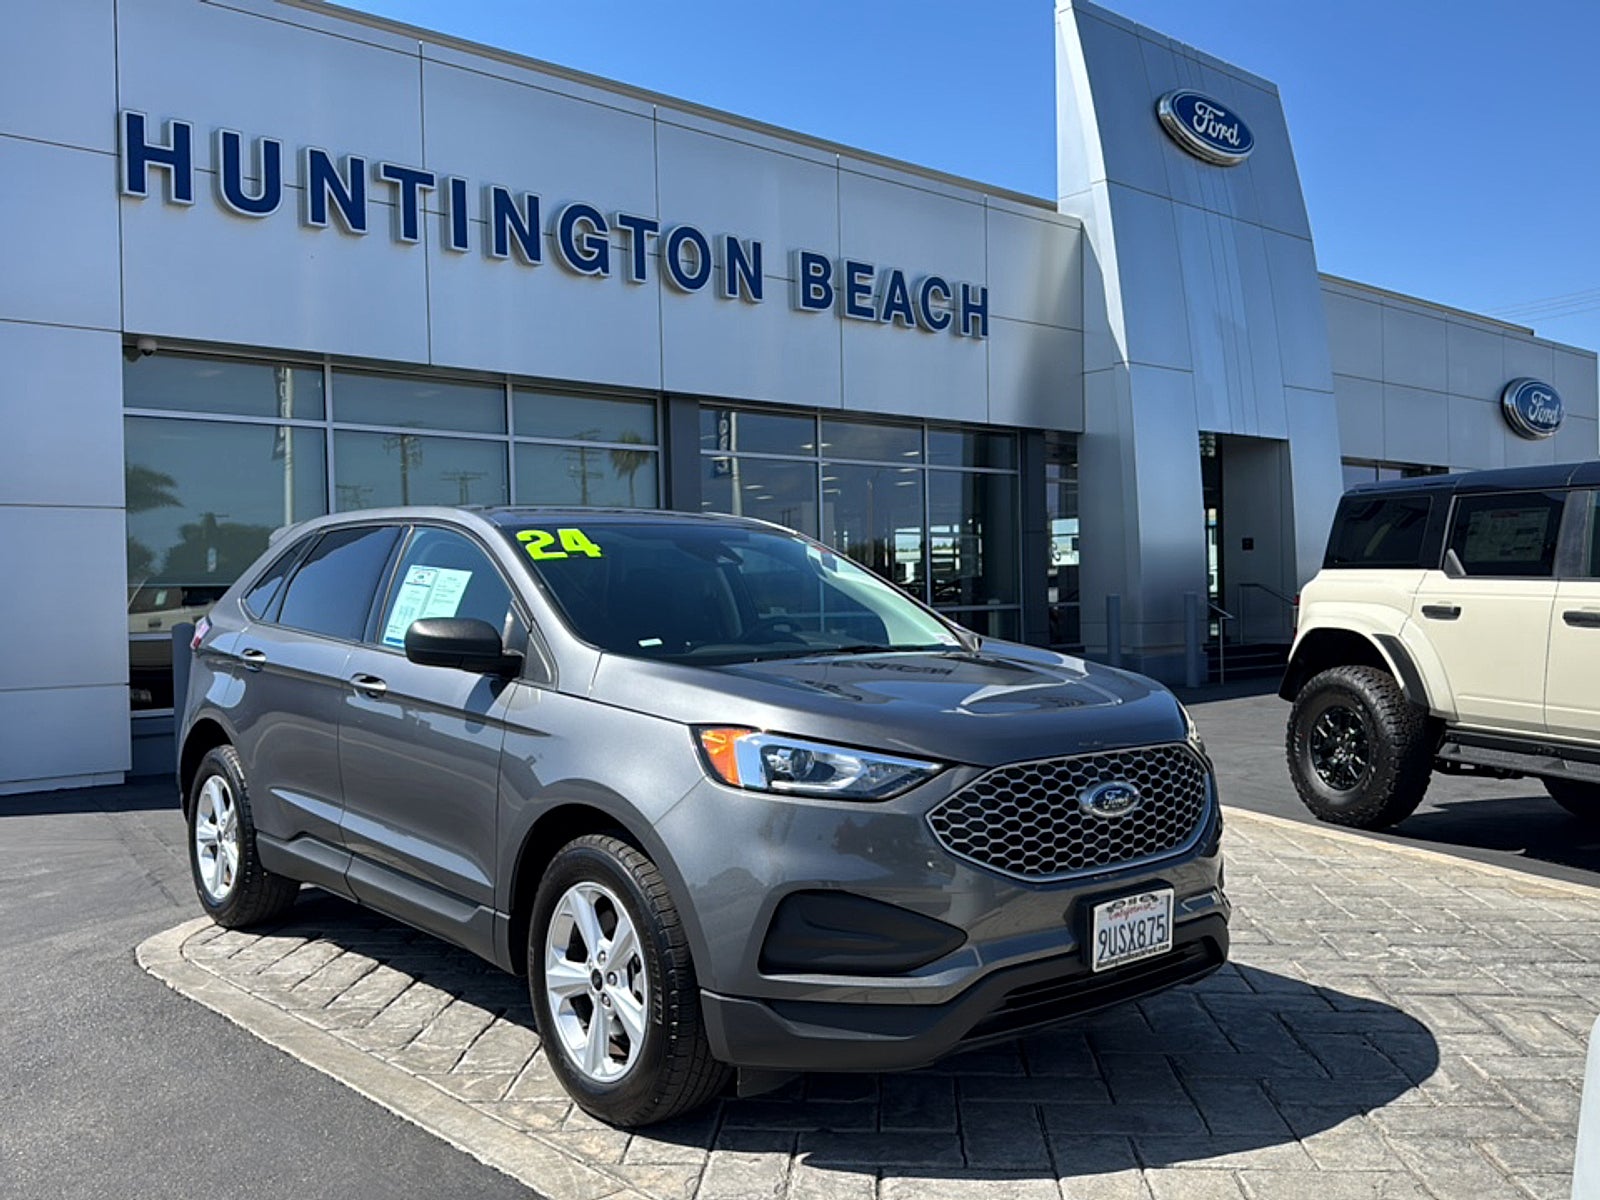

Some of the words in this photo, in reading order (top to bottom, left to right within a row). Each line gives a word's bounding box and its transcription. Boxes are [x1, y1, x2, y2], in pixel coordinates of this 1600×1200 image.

[1193, 101, 1241, 146] Ford
[121, 110, 763, 303] HUNTINGTON
[797, 248, 989, 339] BEACH
[1528, 391, 1560, 425] Ford
[515, 528, 602, 560] 24
[1103, 789, 1130, 810] Ford
[1098, 914, 1165, 960] 9USX875
